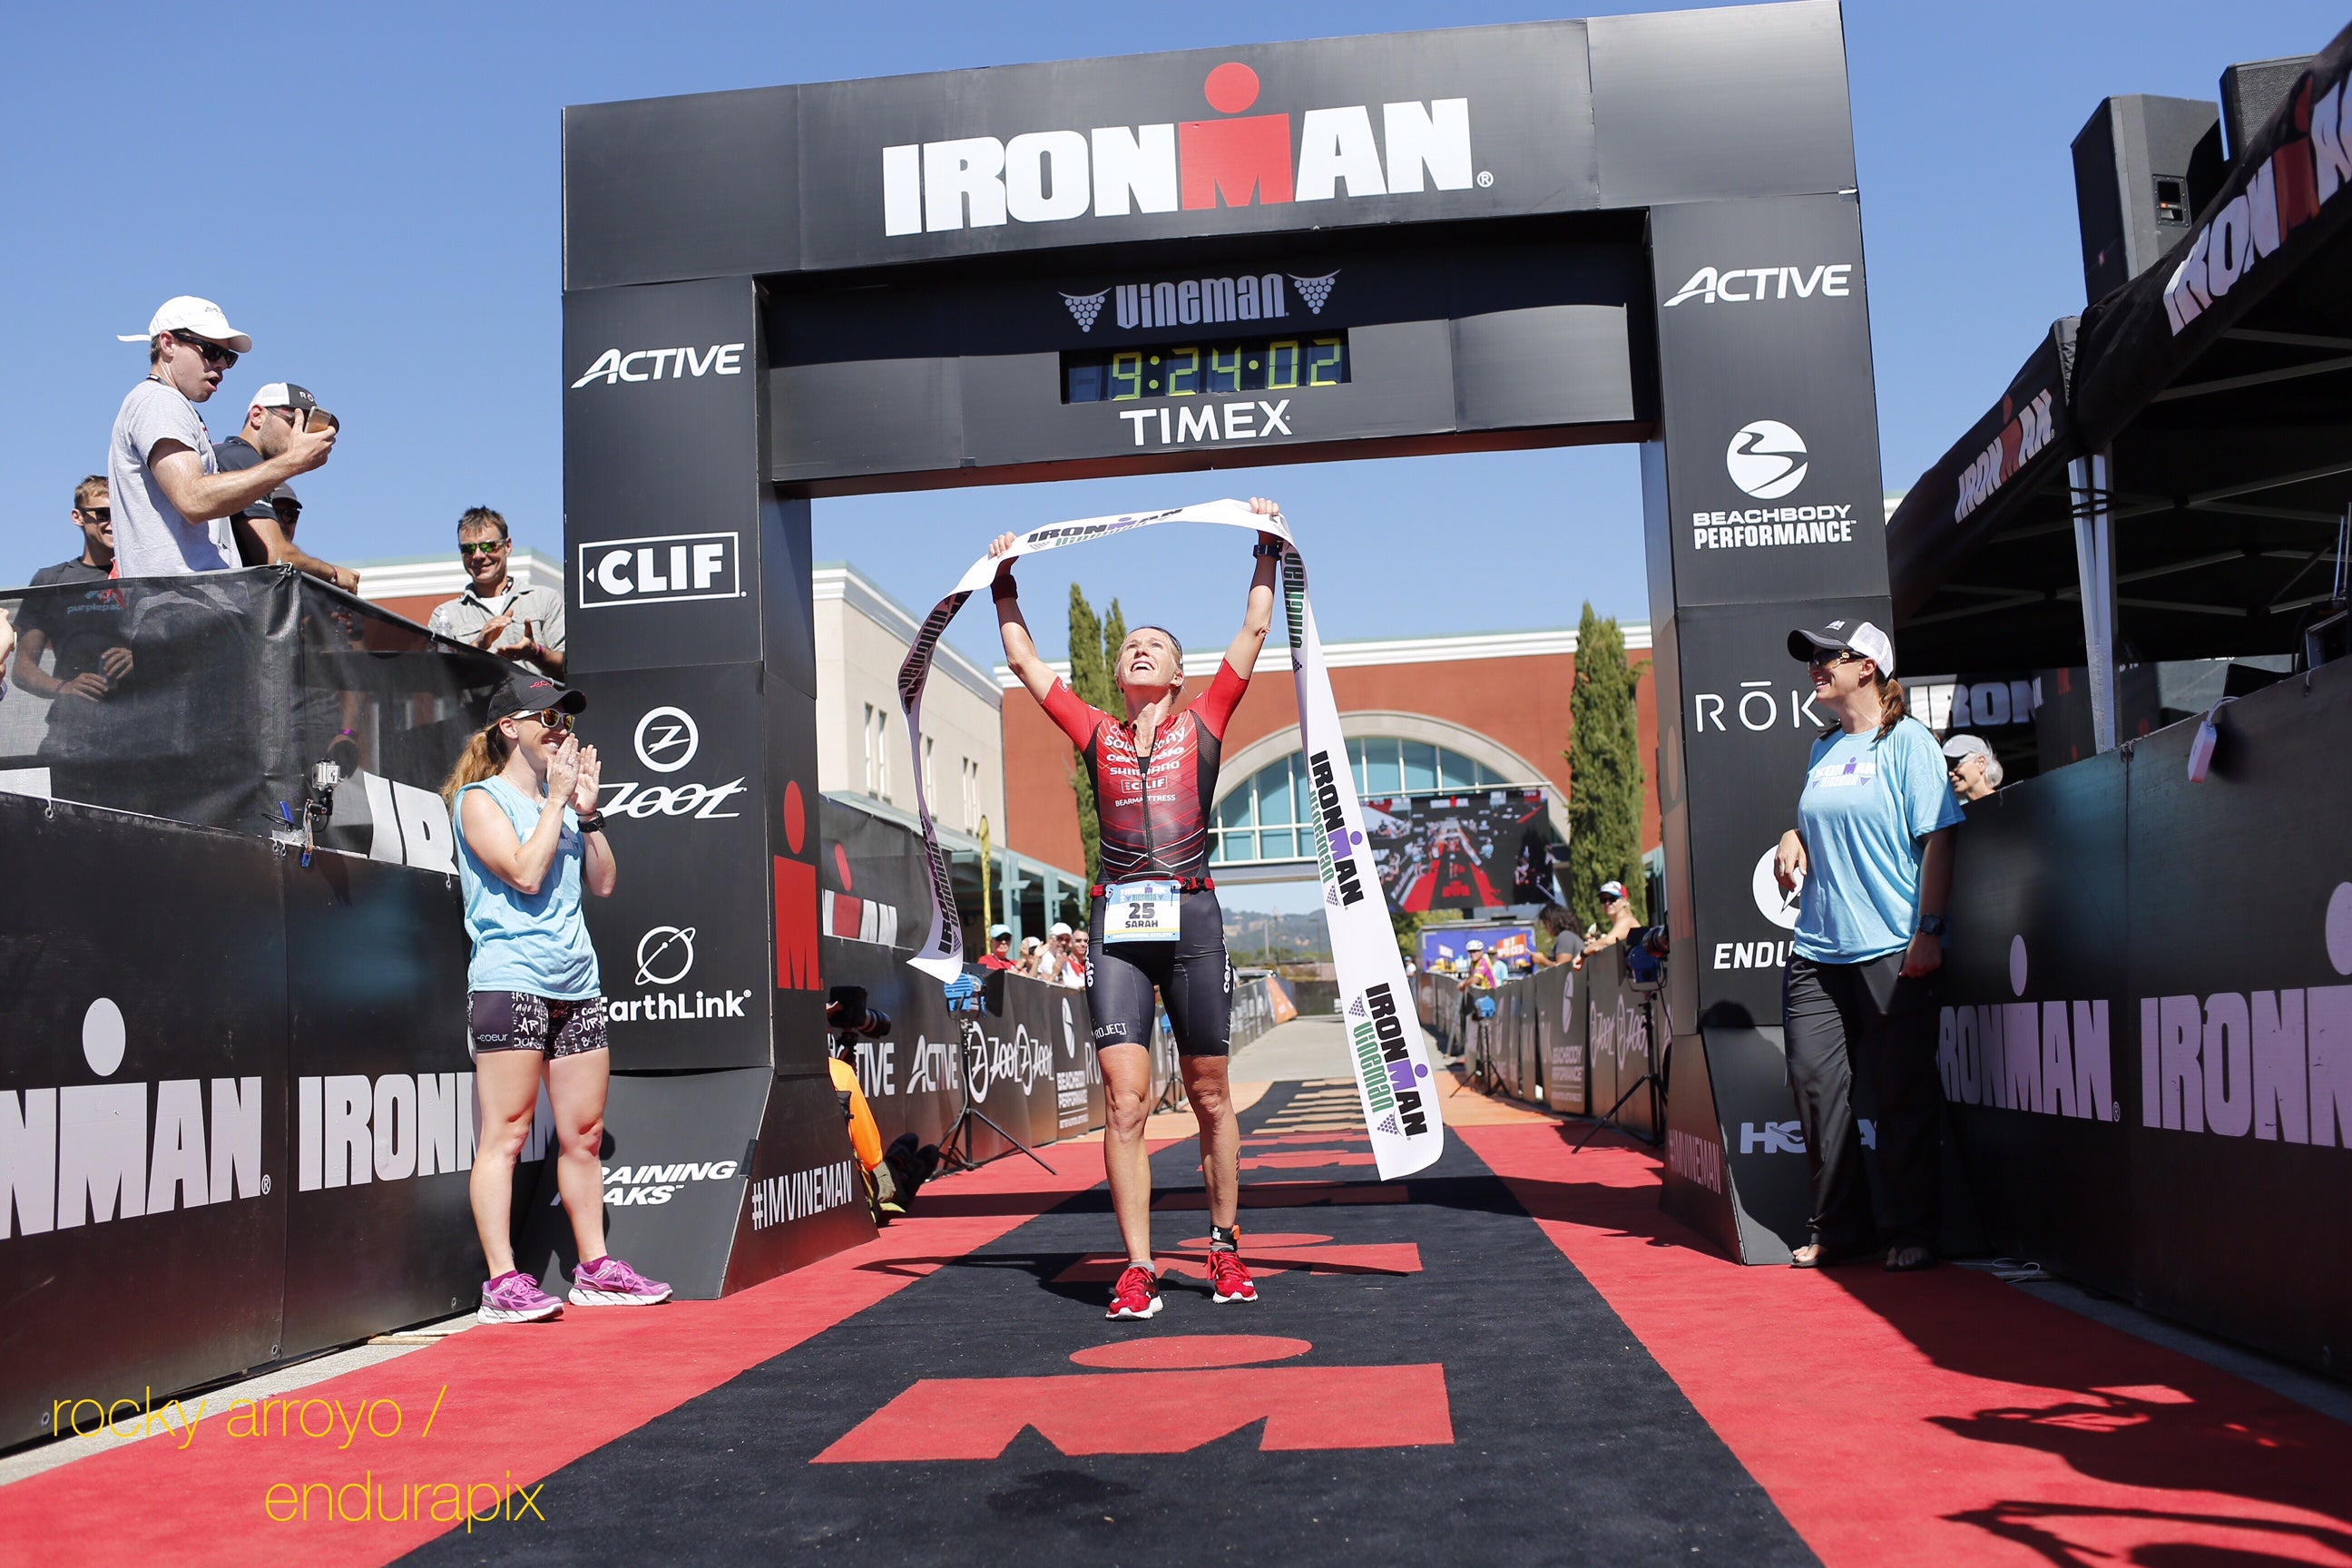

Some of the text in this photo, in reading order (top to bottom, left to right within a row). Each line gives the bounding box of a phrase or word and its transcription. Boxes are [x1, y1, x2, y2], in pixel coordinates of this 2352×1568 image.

[883, 63, 1473, 237] IRONMAN
[1663, 264, 1852, 307] ACTIVE
[571, 343, 745, 388] ACTIVE
[1120, 399, 1292, 446] TIMEX
[1692, 505, 1852, 527] BEACHBODY
[1694, 520, 1853, 550] PERFORMANCE
[598, 543, 723, 595] CLIF
[1310, 750, 1364, 906] IRONMAN
[1125, 920, 1158, 928] SARAH
[1129, 903, 1155, 919] 25
[1366, 983, 1427, 1136] IRONMAN
[1936, 999, 2113, 1122] RONMAN
[751, 1160, 852, 1230] #IMVINEMAN
